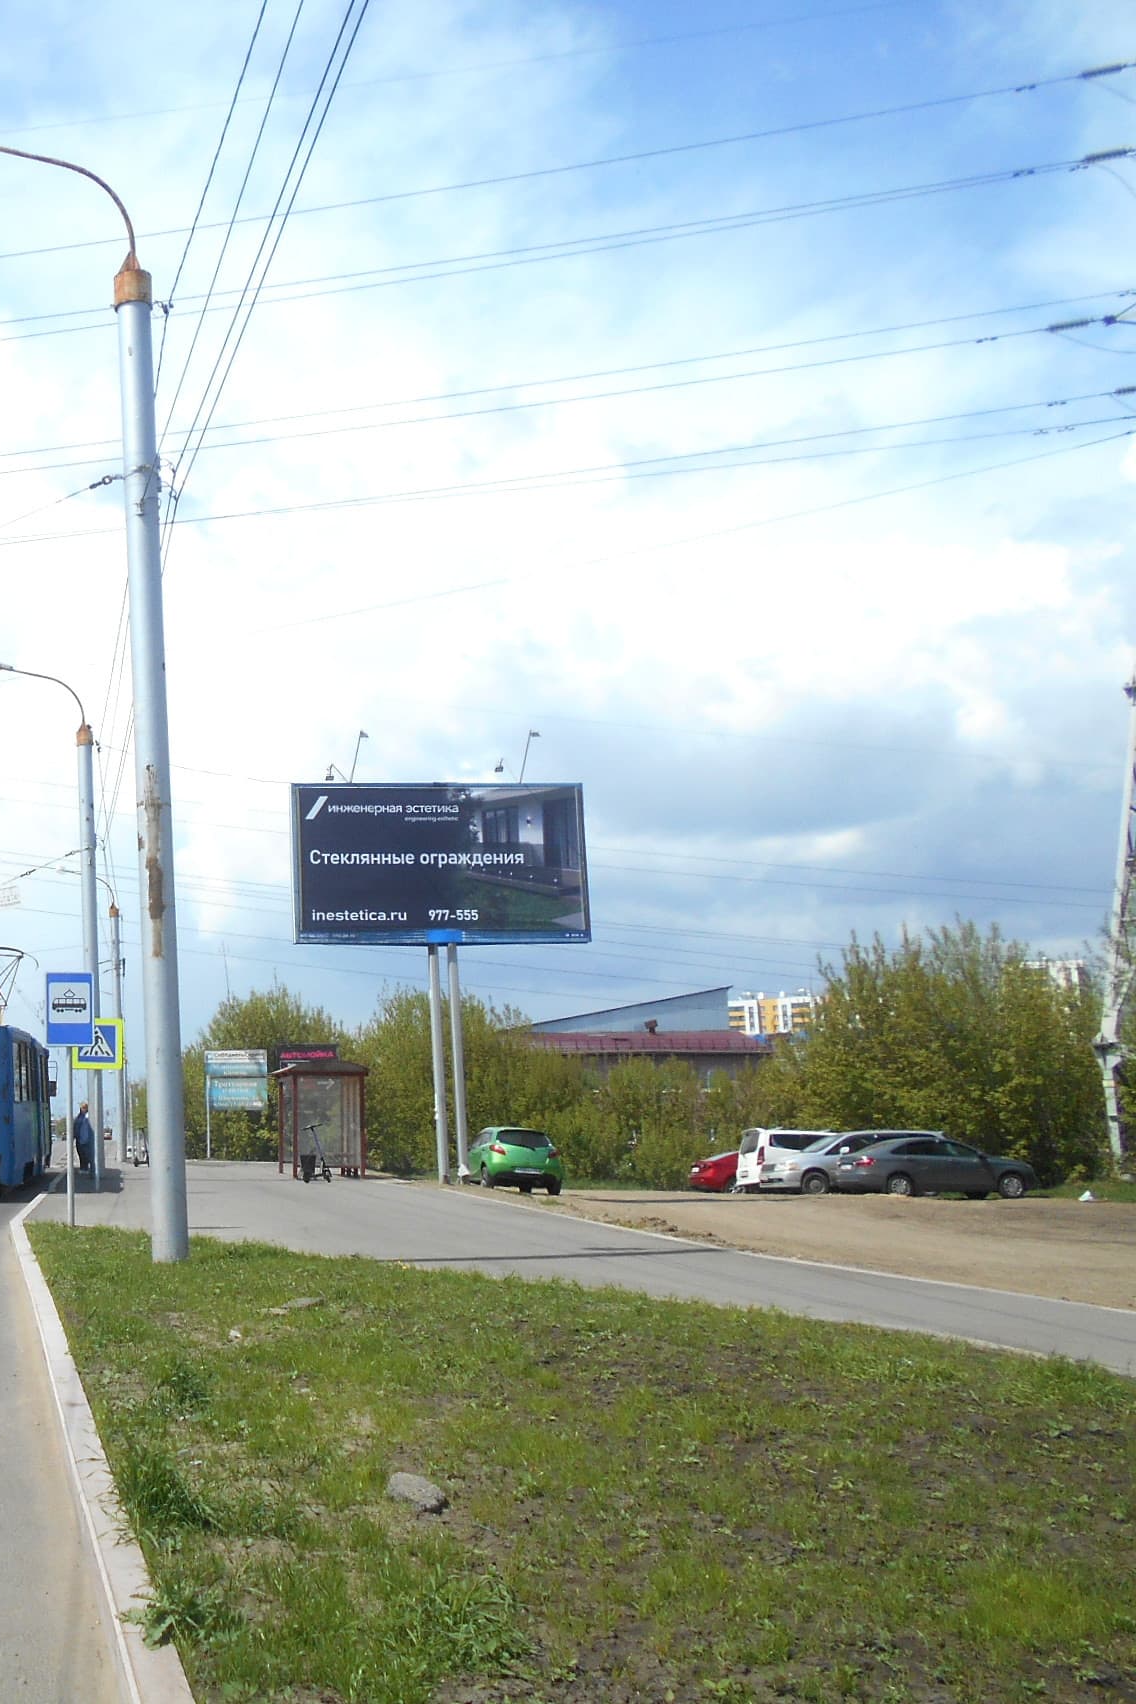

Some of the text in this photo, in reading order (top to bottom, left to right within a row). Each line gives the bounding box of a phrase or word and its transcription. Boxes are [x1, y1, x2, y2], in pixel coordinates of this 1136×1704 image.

[327, 804, 459, 816] инженерная эстетика
[309, 850, 525, 868] Стеклянные ограждения
[311, 909, 479, 921] inestetica.ru 977-555
